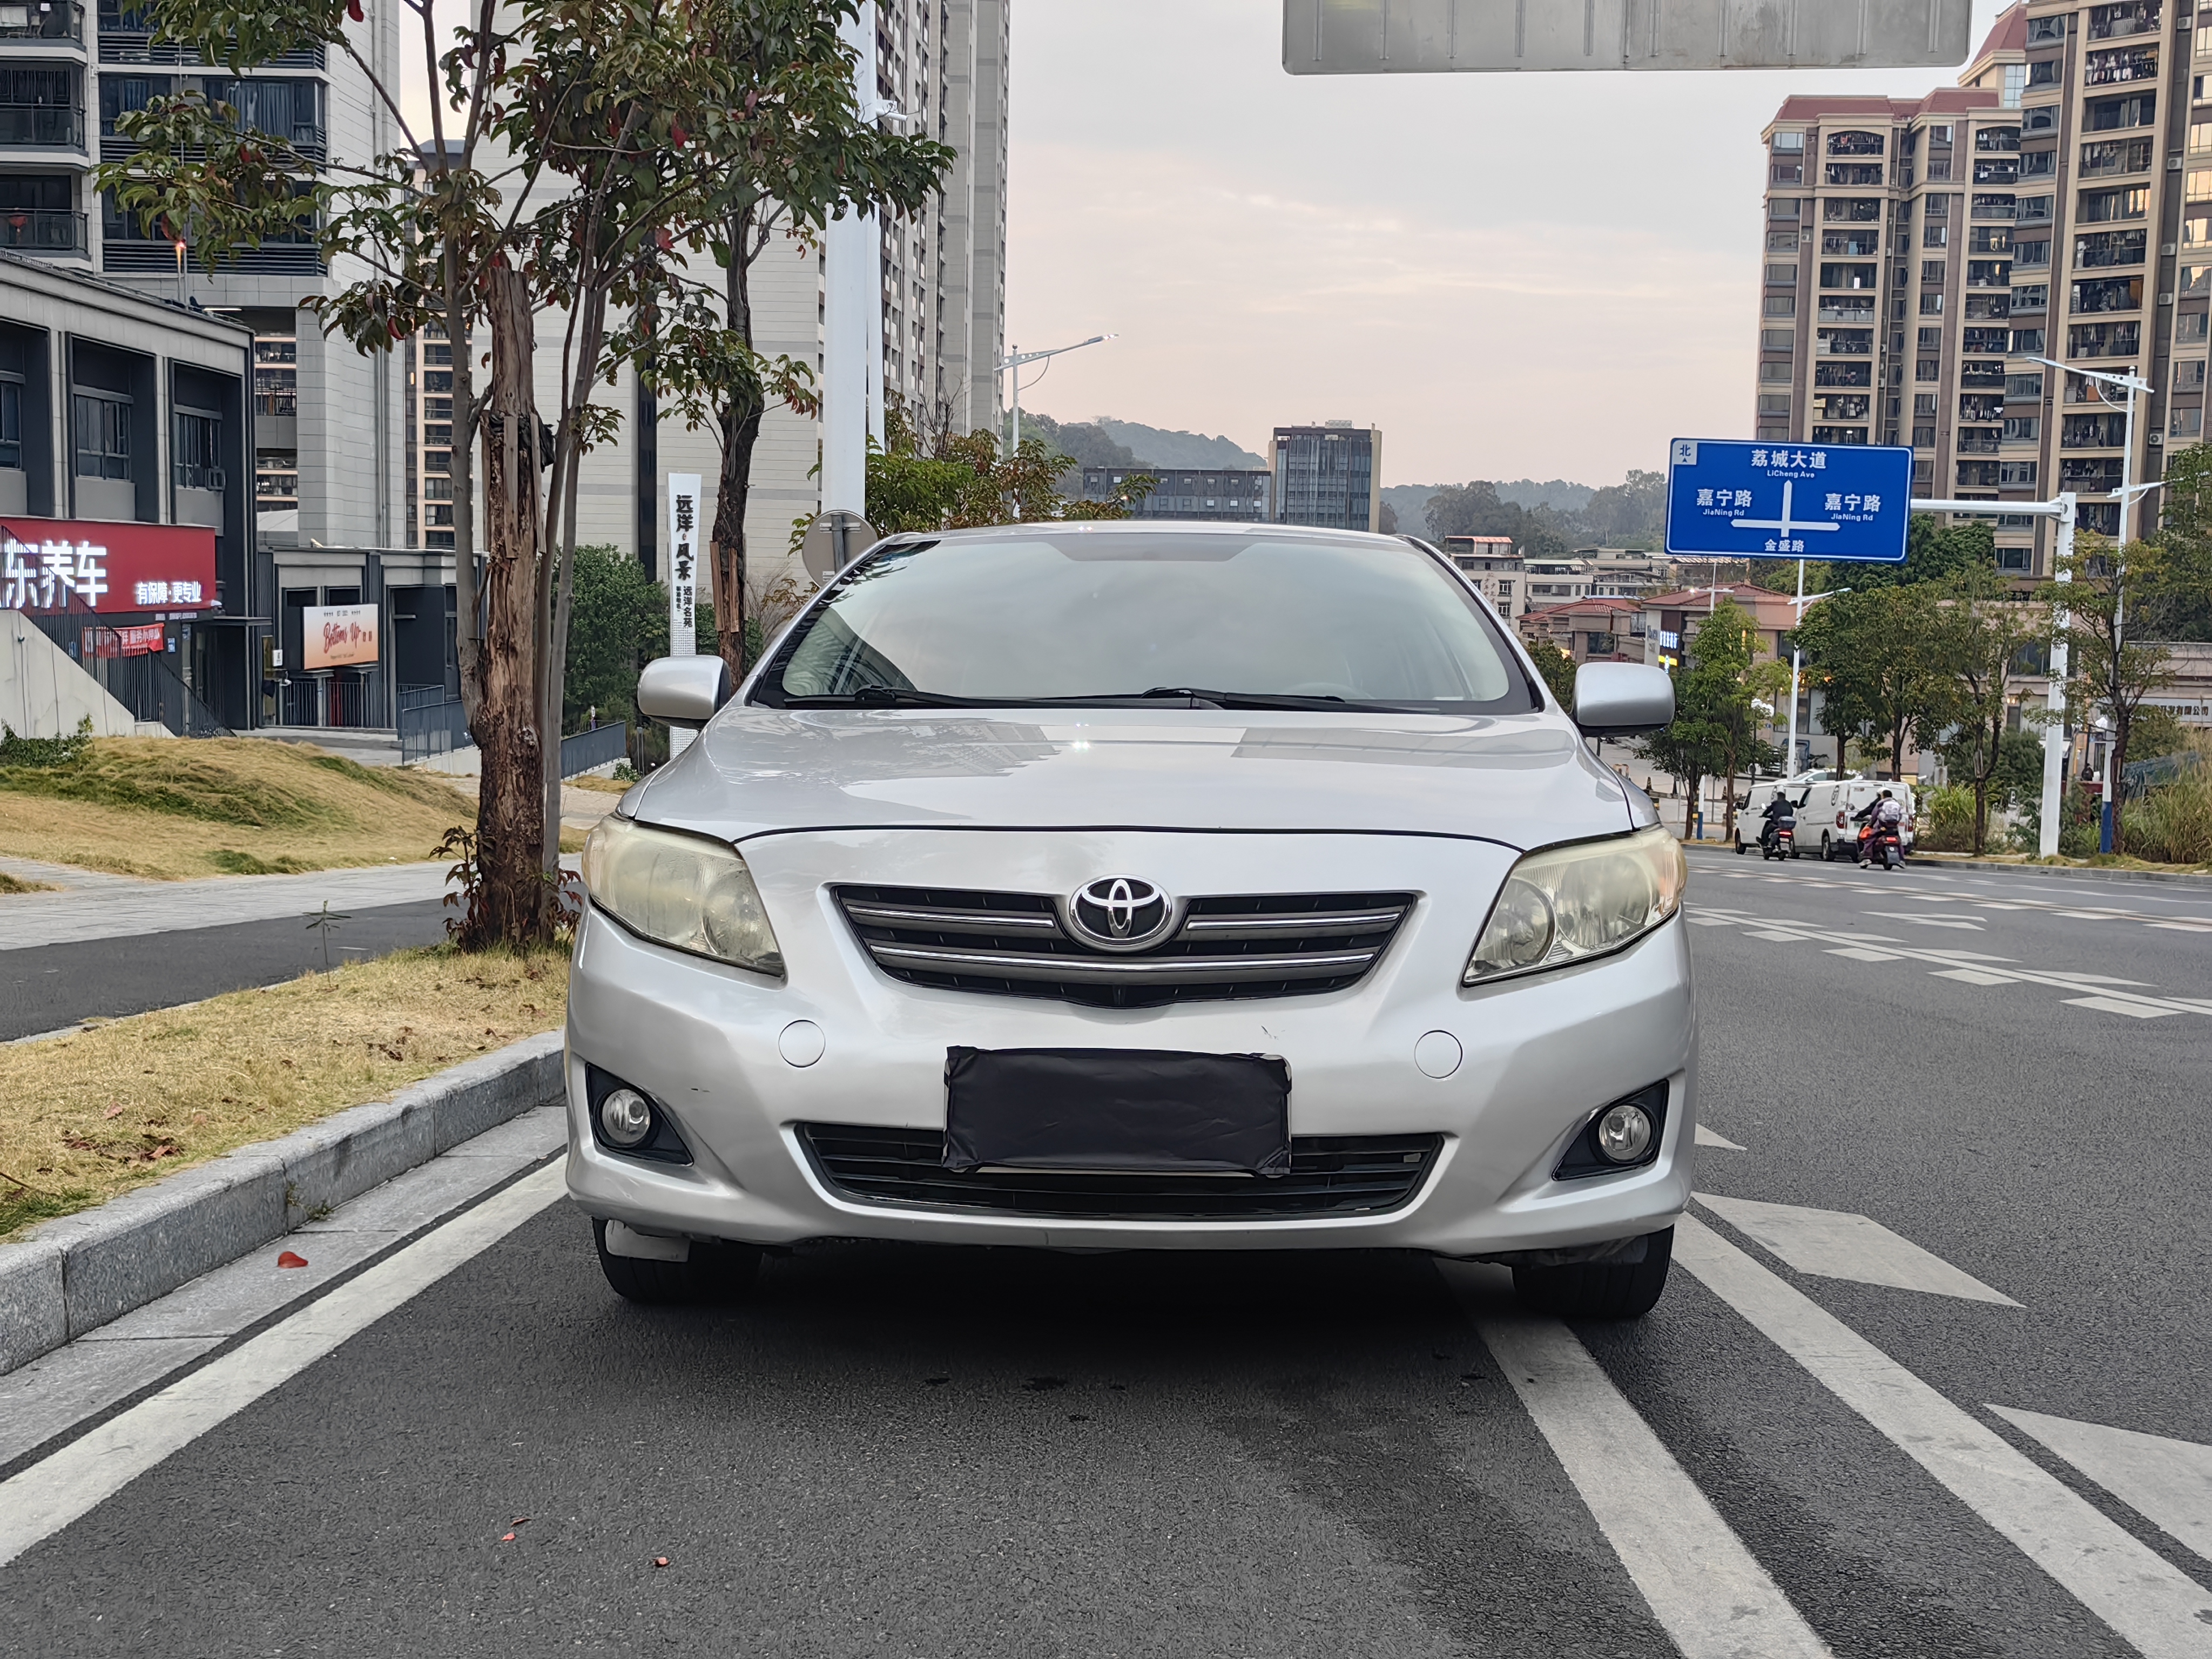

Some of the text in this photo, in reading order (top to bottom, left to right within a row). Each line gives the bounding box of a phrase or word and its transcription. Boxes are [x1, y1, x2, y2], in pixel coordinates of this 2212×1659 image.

[1680, 444, 1691, 457] 北
[1751, 449, 1826, 469] 荔城大道
[1767, 470, 1798, 478] LiCheng
[1697, 489, 1752, 507] 嘉宁路
[1825, 493, 1881, 512] 嘉宁路
[1703, 509, 1732, 517] JiaNing
[1831, 513, 1860, 521] JiaNing
[1765, 539, 1804, 552] 金盛路
[684, 585, 692, 627] 远洋名苑
